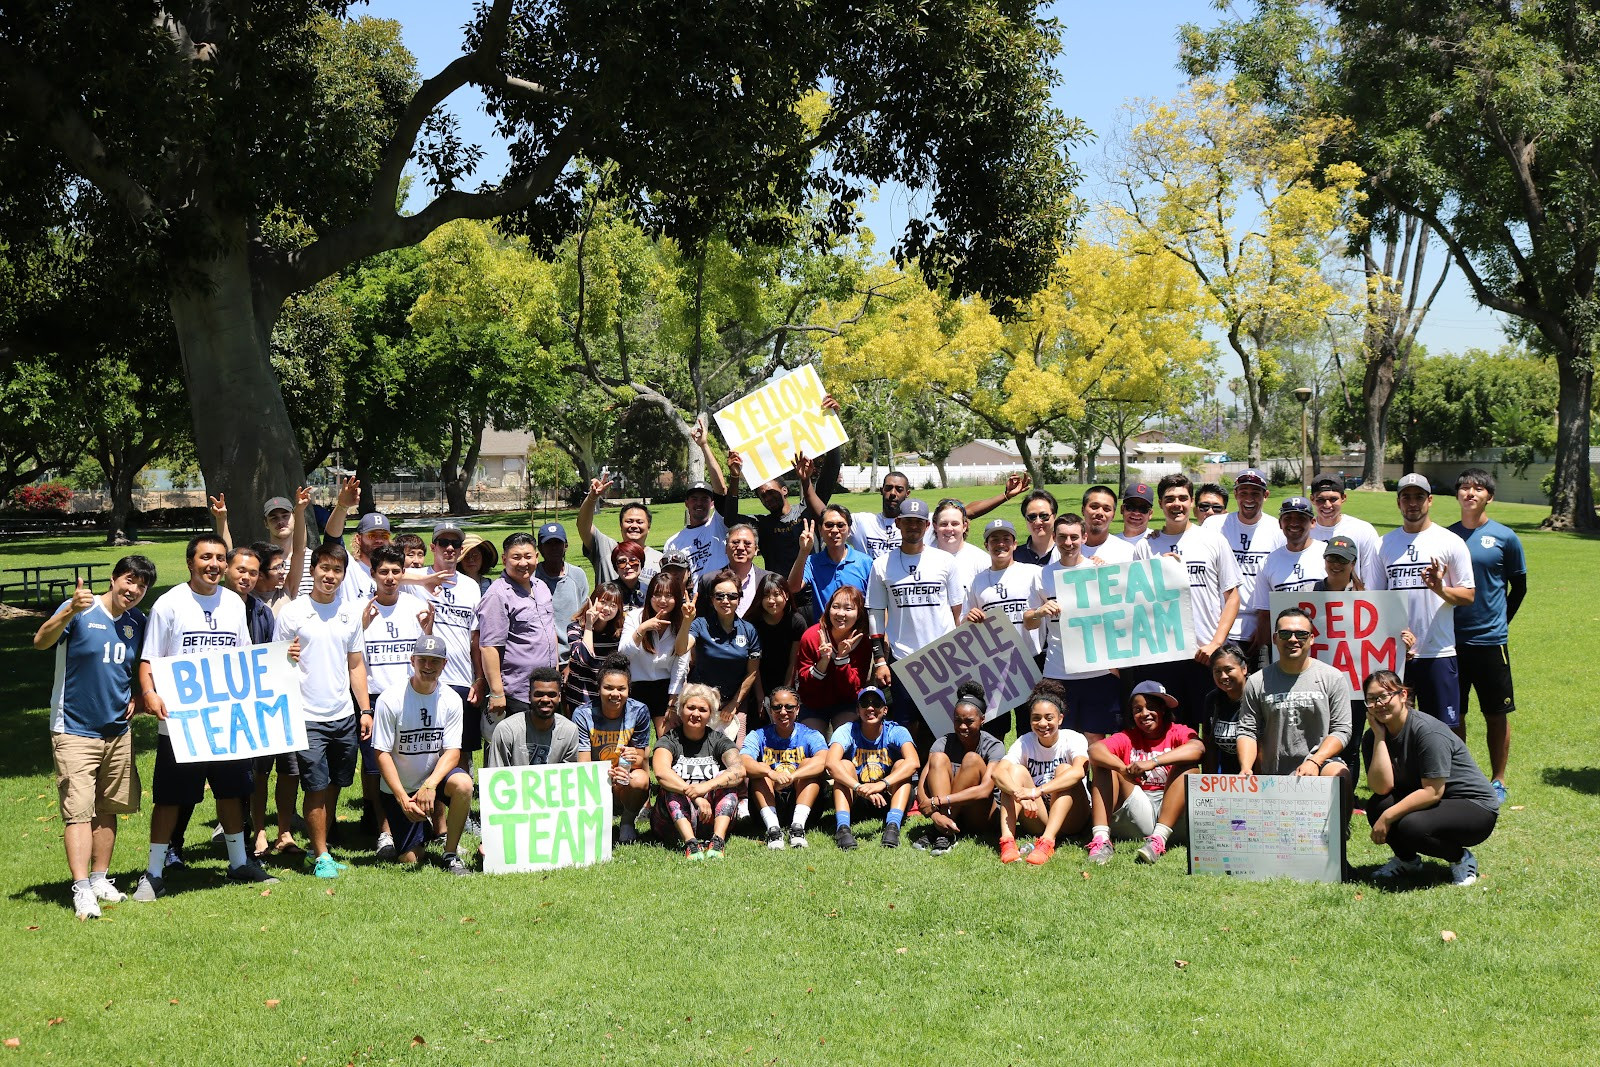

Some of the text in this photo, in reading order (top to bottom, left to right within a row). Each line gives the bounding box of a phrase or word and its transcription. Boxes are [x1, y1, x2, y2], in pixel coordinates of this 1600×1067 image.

[720, 367, 822, 441] YELLOW
[734, 410, 846, 481] TEAM
[1408, 474, 1416, 484] B
[1136, 484, 1146, 494] C
[911, 501, 920, 512] B
[374, 515, 383, 526] B
[994, 518, 1004, 527] B
[867, 540, 902, 551] BETHES
[1240, 533, 1251, 551] BU
[1407, 544, 1419, 562] BU
[909, 565, 921, 582] BU
[1293, 563, 1304, 580] BU
[994, 583, 1008, 599] BU
[1062, 558, 1180, 609] TEAL
[203, 610, 218, 631] BU
[1298, 599, 1379, 639] RED
[386, 621, 399, 639] BU
[1068, 600, 1185, 664] TEAM
[102, 641, 126, 665] 10
[425, 638, 435, 650] B
[904, 615, 1015, 696] PURPLE
[171, 648, 274, 705] BLUE
[923, 646, 1036, 722] TAM
[167, 693, 294, 757] TEAM
[420, 708, 432, 727] BU
[400, 731, 444, 744] BETHESD
[488, 763, 602, 811] GREEN
[1200, 775, 1259, 793] SPORTS
[1195, 798, 1214, 808] GAME
[488, 805, 605, 865] TEAM
